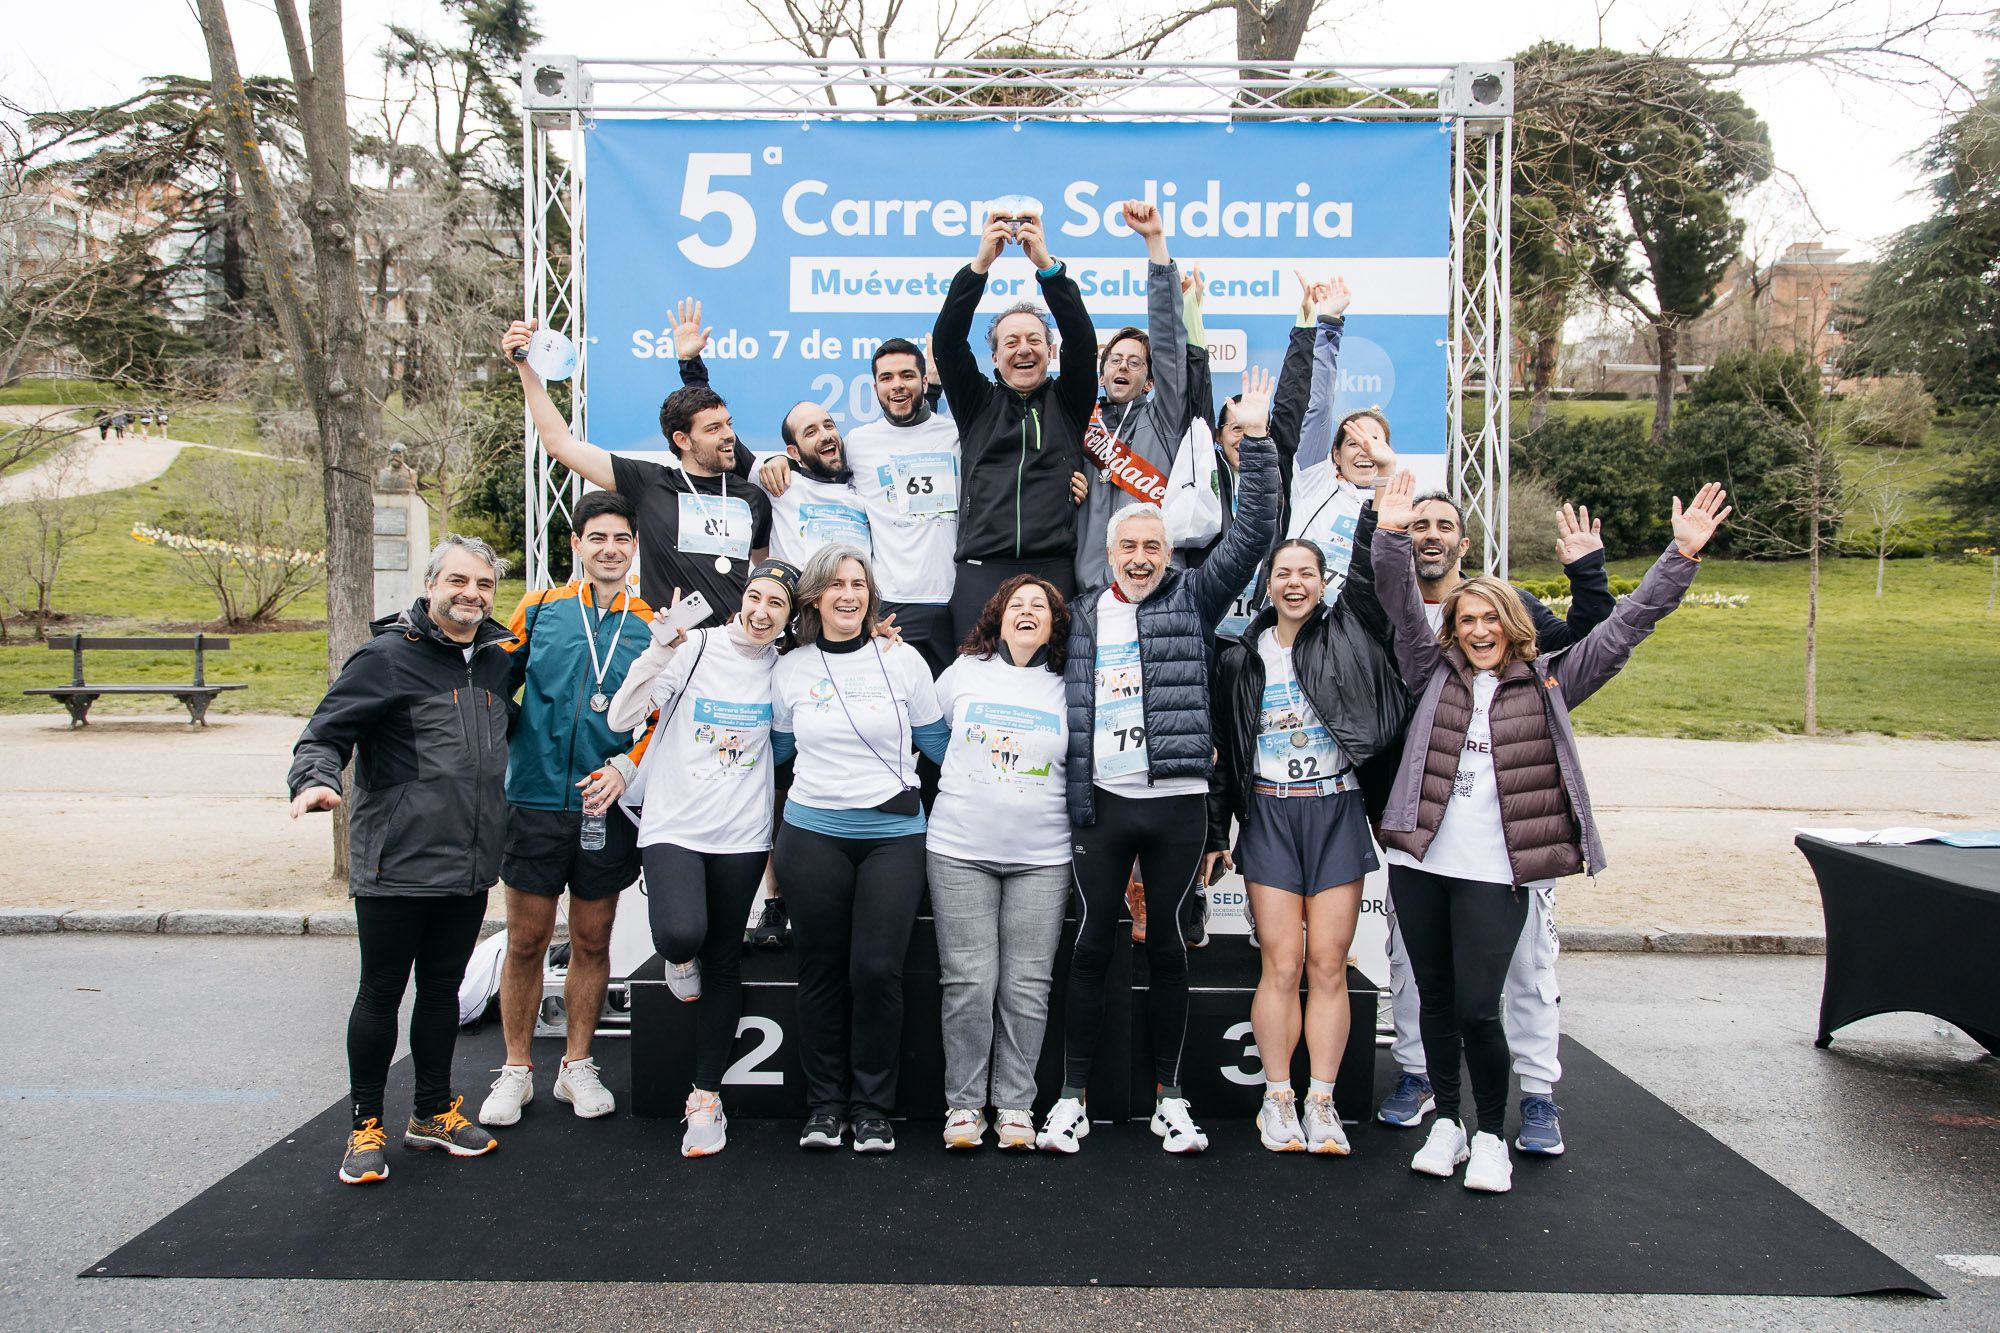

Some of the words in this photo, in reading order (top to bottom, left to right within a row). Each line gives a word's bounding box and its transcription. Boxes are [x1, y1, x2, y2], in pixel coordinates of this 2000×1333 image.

[782, 180, 994, 237] Carrer
[984, 279, 1024, 296] or
[1080, 269, 1148, 296] Salu
[631, 330, 759, 359] Sáado
[769, 331, 789, 359] 7
[800, 329, 842, 359] de
[1207, 345, 1237, 361] RID
[1334, 368, 1382, 393] km
[1084, 427, 1167, 501] Felicidade
[907, 476, 934, 495] 63
[1113, 726, 1146, 752] 79
[1288, 756, 1320, 779] 82
[1213, 893, 1249, 905] SED
[720, 1016, 784, 1085] 2
[1220, 1021, 1267, 1086] 3
